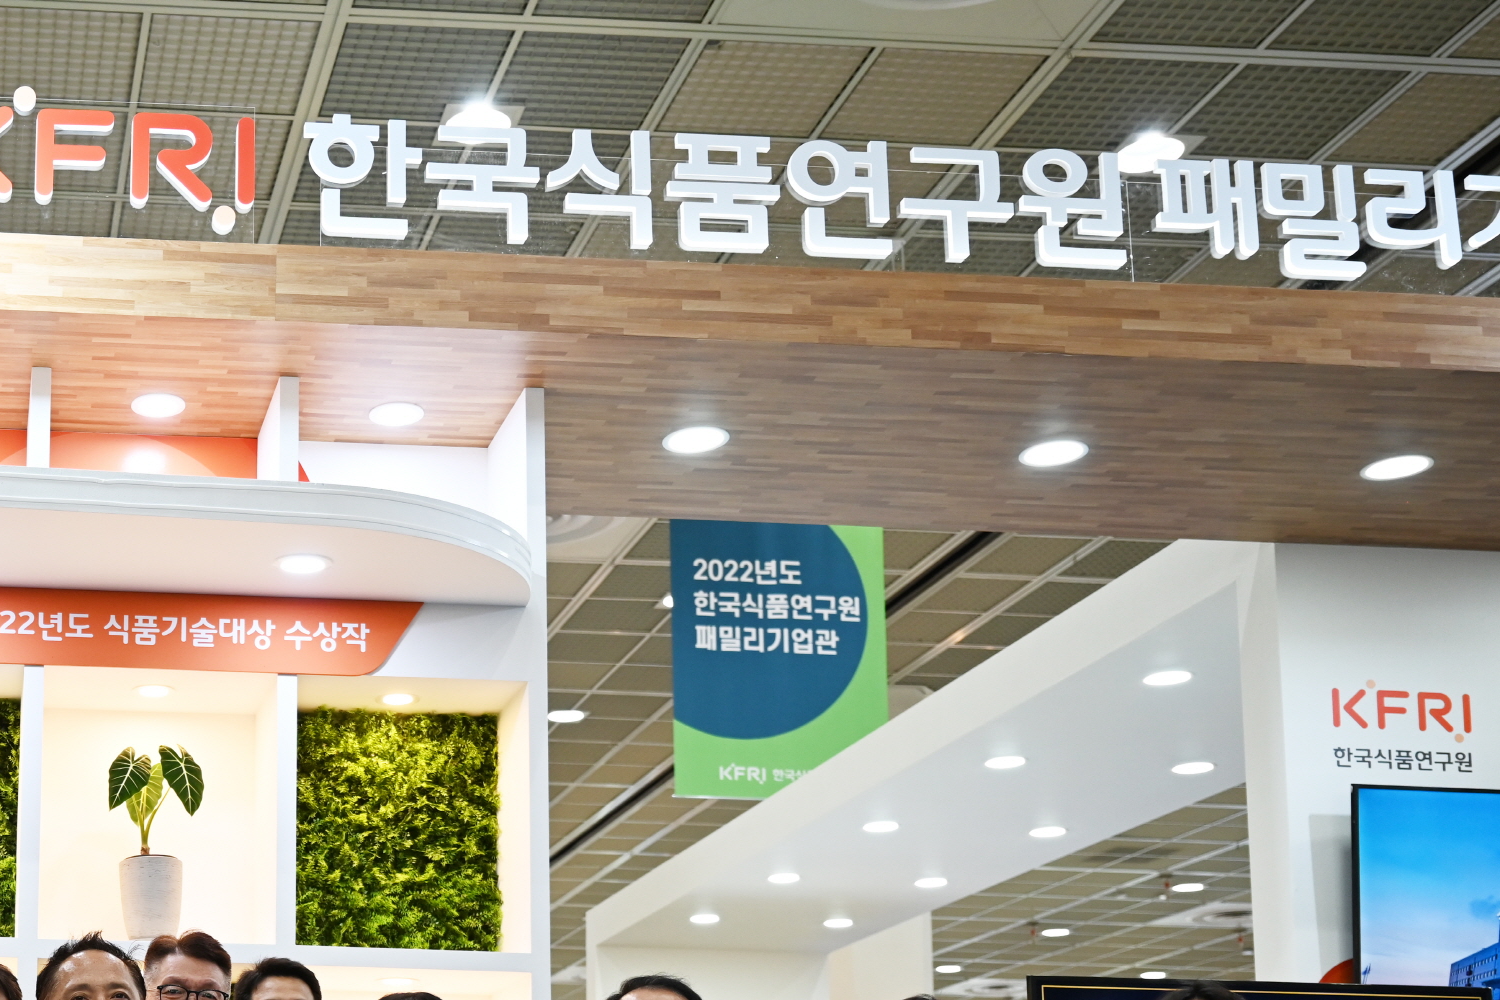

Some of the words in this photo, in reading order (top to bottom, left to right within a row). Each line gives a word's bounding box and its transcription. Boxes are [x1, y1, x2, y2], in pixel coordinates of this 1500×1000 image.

[303, 113, 1128, 271] 한국식품연구원
[693, 558, 802, 585] 2022년도
[693, 590, 861, 622] 한국식품연구원
[103, 613, 276, 650] 식품기술대상
[283, 621, 370, 653] 수상작
[695, 625, 839, 655] 패밀리기업관
[1331, 687, 1472, 734] KFRI
[719, 765, 767, 782] KFRI
[1333, 746, 1473, 773] 한국식품연구원
